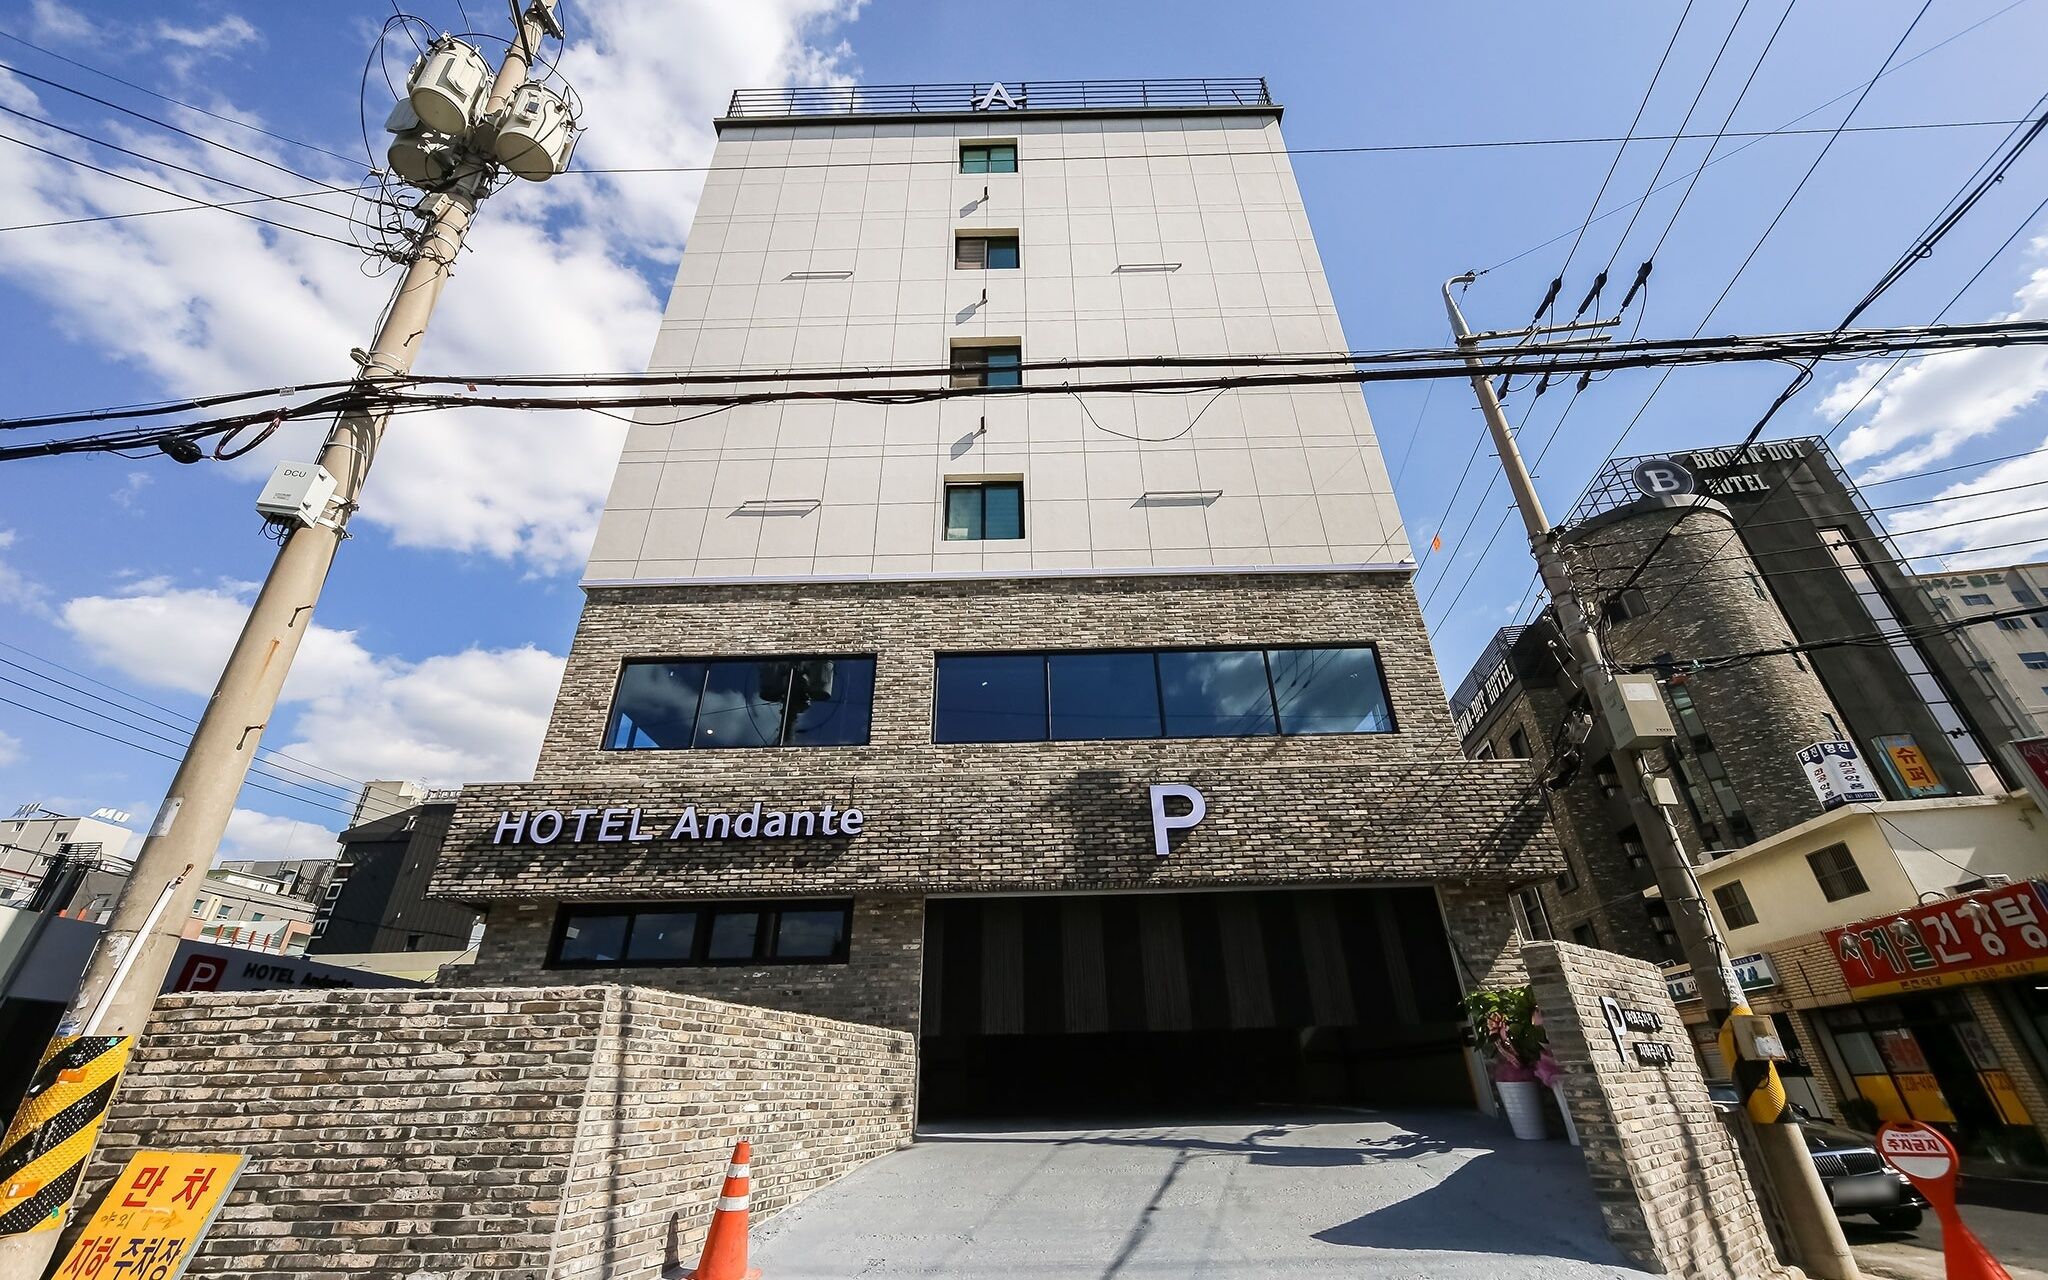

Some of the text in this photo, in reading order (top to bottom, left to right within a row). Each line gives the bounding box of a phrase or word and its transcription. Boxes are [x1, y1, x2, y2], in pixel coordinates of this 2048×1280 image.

[284, 469, 307, 478] DCU
[1645, 469, 1681, 492] B
[1824, 743, 1850, 755] 영진
[1896, 746, 1931, 784] 슈퍼
[493, 801, 865, 845] HOTEL Andante
[1149, 784, 1206, 855] P
[187, 962, 217, 992] P
[243, 962, 294, 984] HOTEL
[1600, 996, 1628, 1062] P
[63, 1236, 121, 1280] 지하
